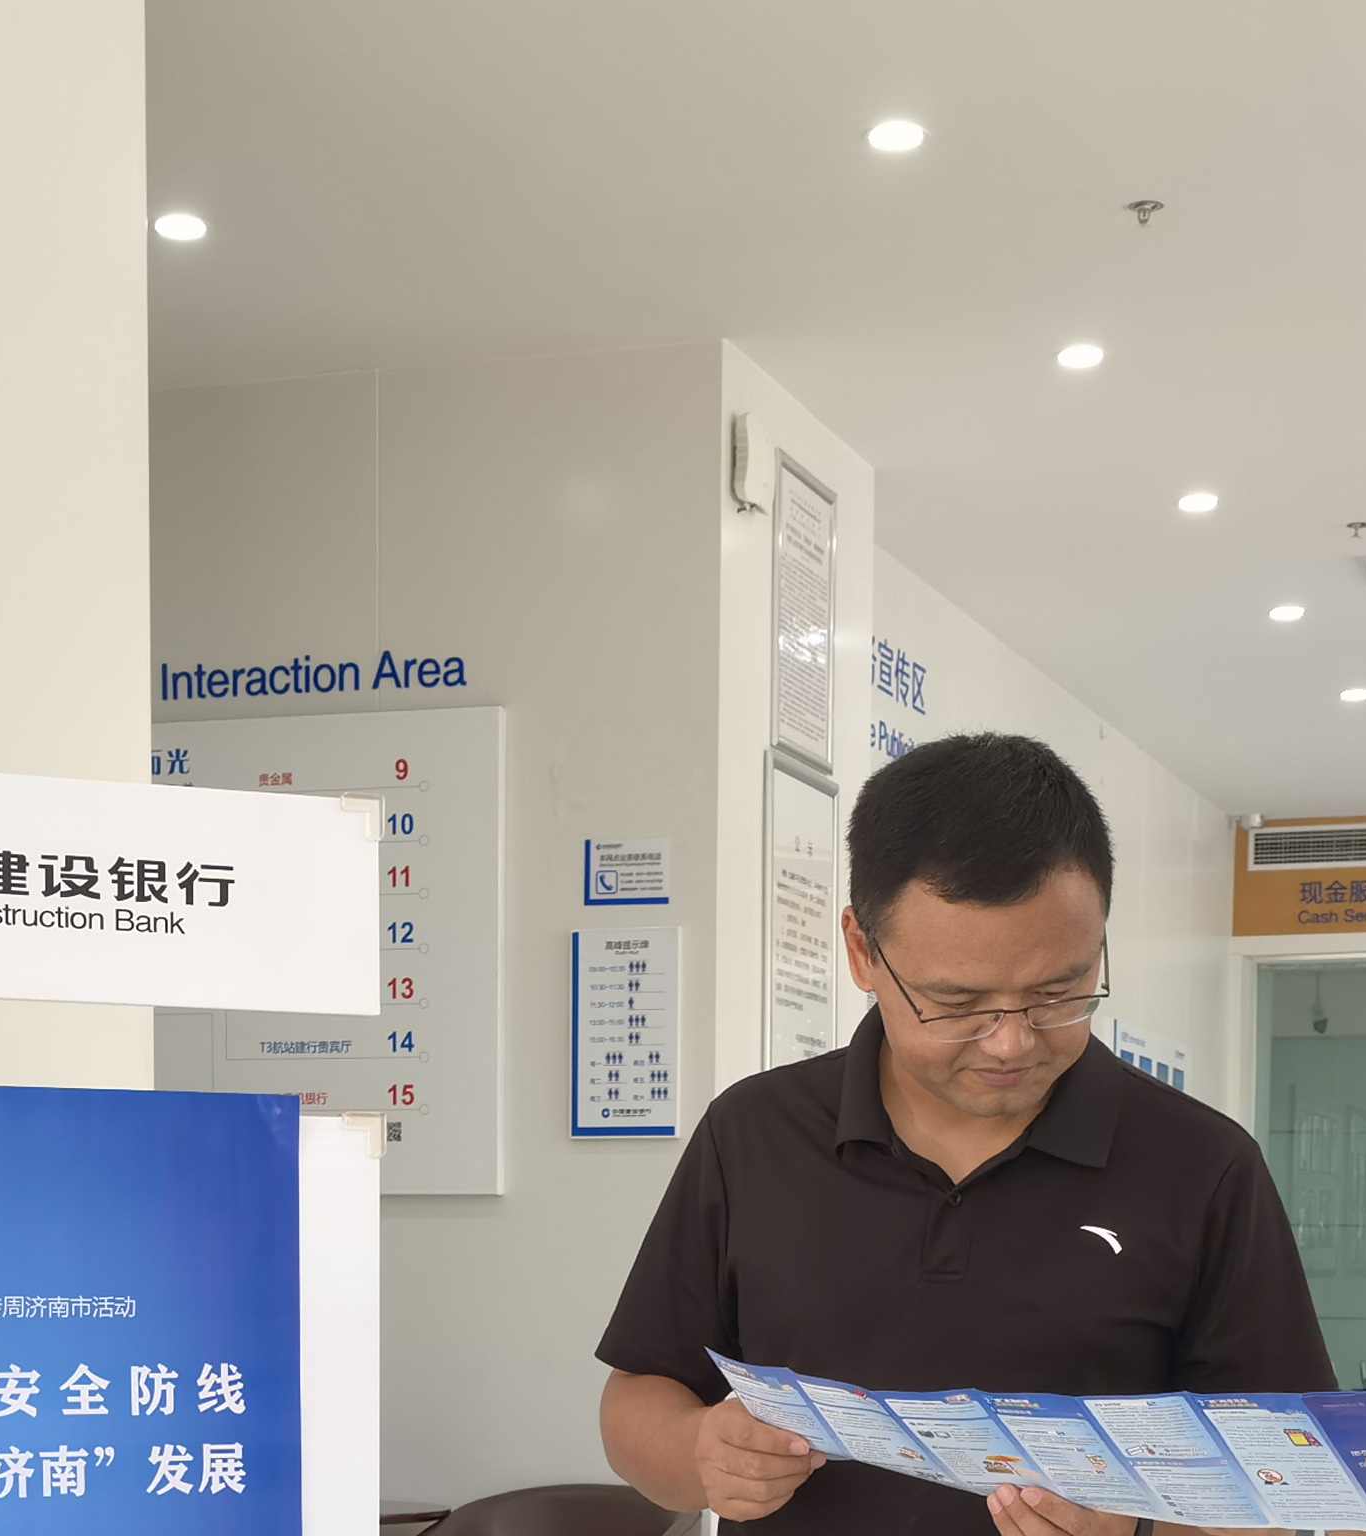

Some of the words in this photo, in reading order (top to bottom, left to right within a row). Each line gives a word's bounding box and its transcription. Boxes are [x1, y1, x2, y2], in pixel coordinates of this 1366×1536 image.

[161, 655, 360, 701] Interaction
[371, 650, 467, 690] Area
[259, 773, 292, 787] 贵金属
[395, 759, 408, 781] 9
[387, 813, 414, 835] 10
[387, 866, 411, 888] 11
[114, 910, 186, 935] Bank
[1298, 909, 1338, 924] Cash
[387, 922, 414, 944] 12
[387, 978, 414, 1000] 13
[260, 1040, 352, 1053] T3航站建行贵宾厅
[387, 1031, 415, 1053] 14
[387, 1084, 415, 1106] 15
